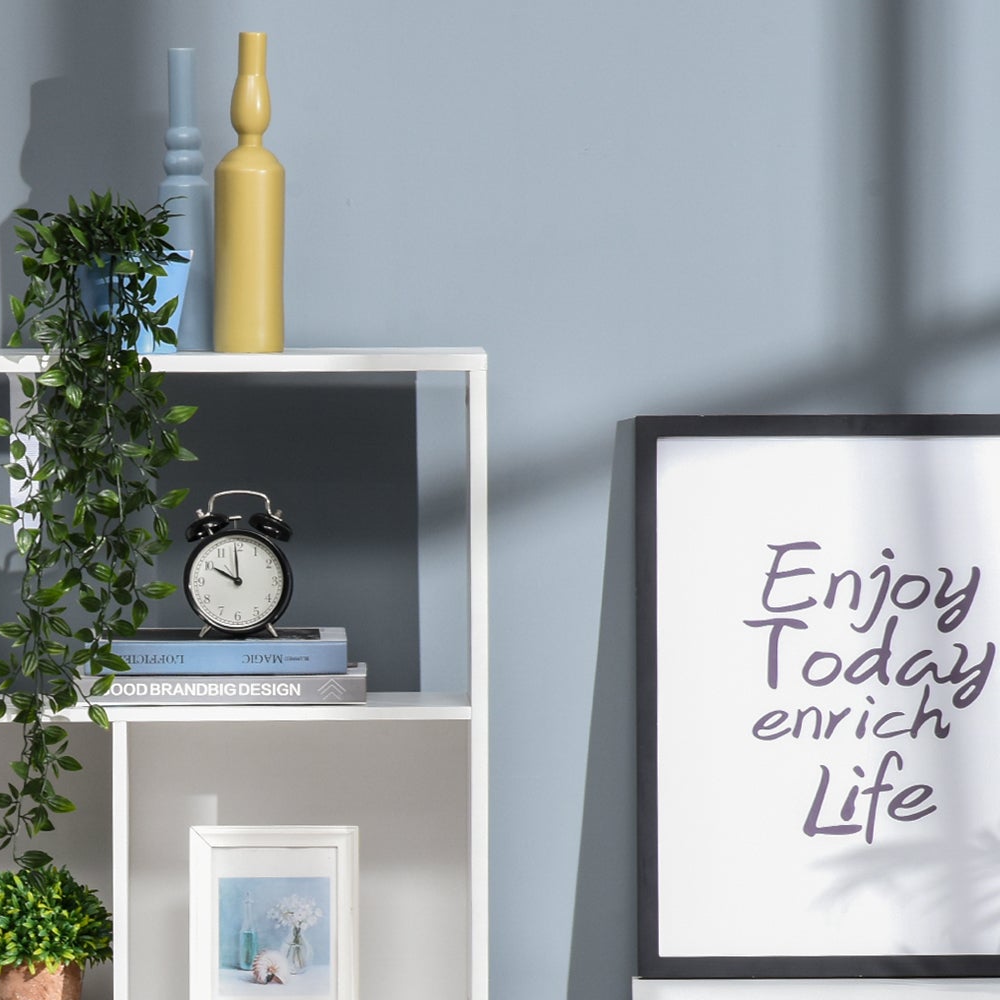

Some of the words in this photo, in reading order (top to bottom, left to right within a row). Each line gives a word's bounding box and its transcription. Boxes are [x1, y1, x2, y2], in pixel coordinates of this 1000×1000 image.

[762, 541, 981, 633] Enjoy
[119, 654, 184, 664] L'OFFICIE
[242, 654, 283, 664] MAGIC
[742, 615, 996, 709] Today
[103, 683, 147, 696] OOD
[239, 683, 300, 696] DESIGN
[752, 684, 950, 741] enrich
[803, 750, 937, 844] Life
